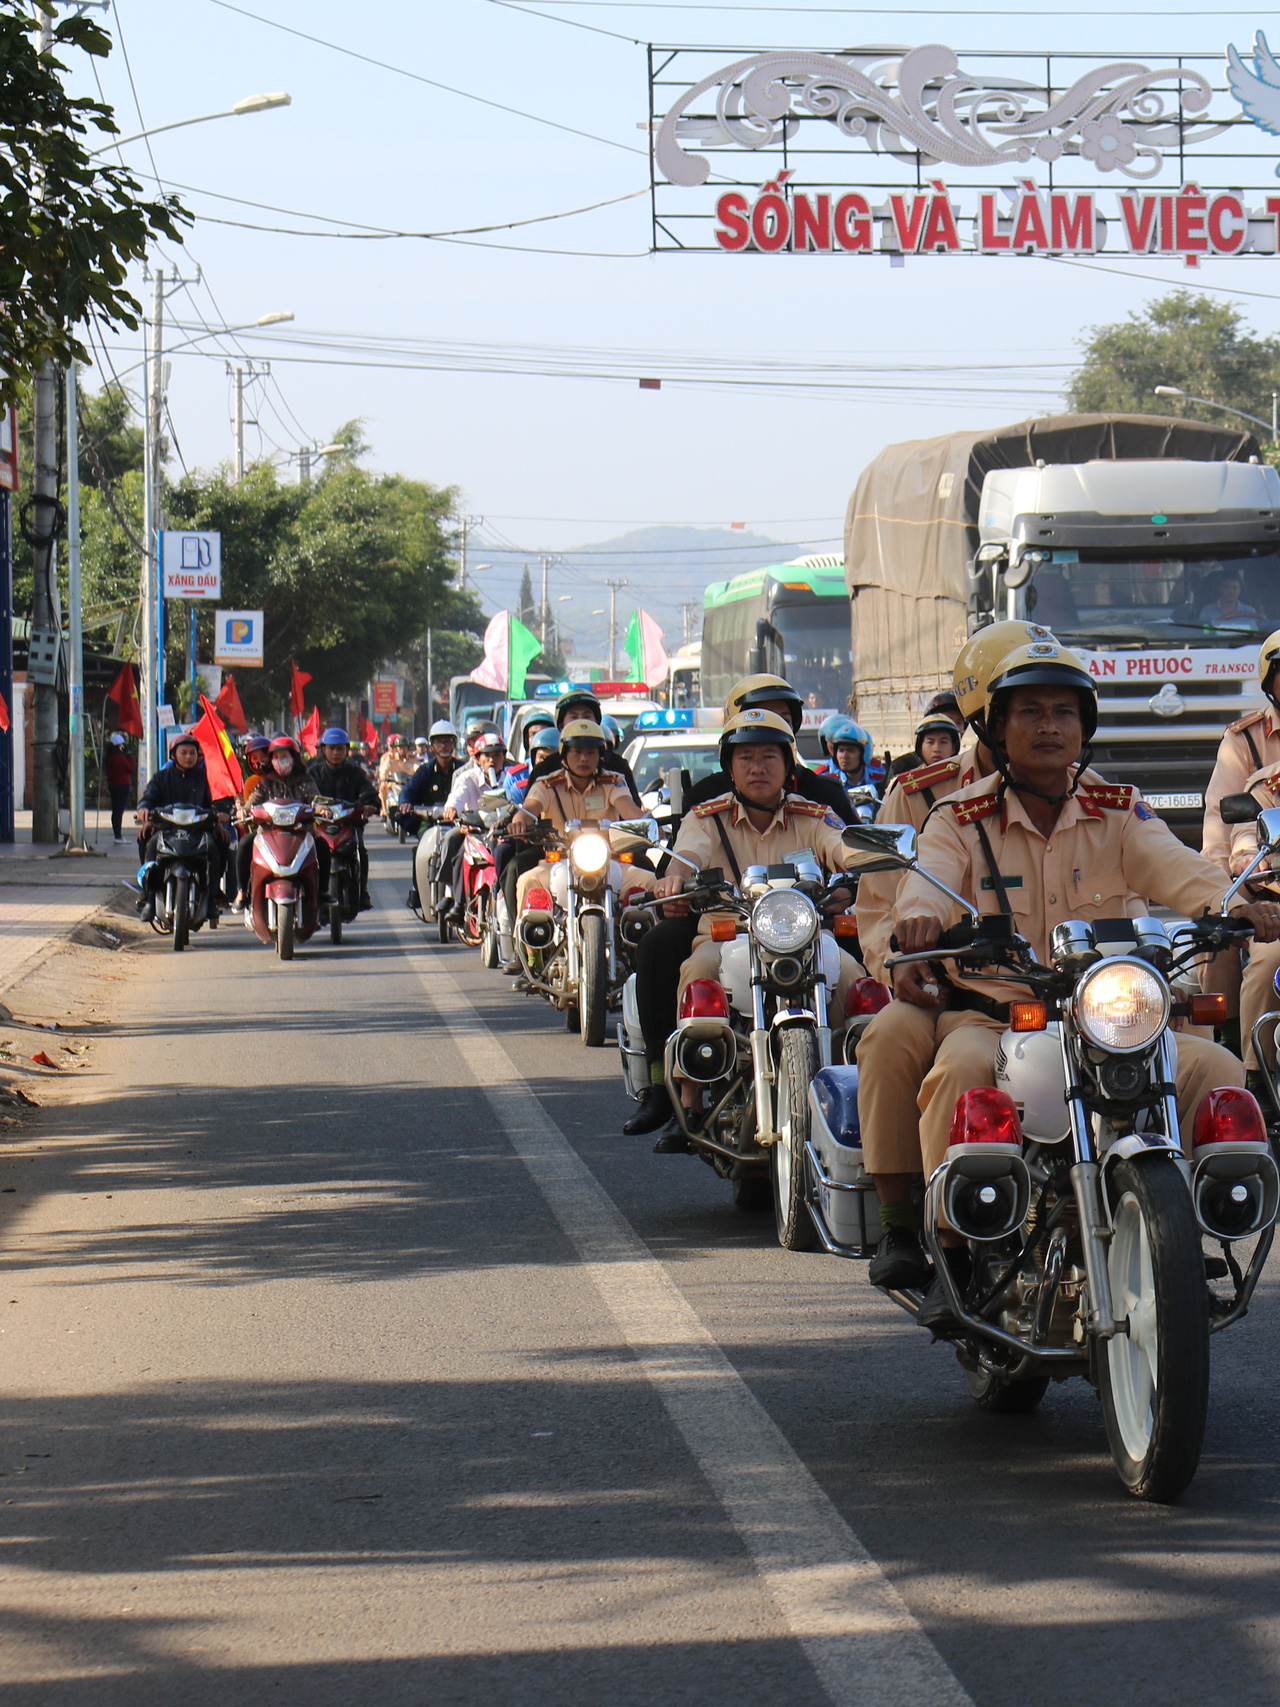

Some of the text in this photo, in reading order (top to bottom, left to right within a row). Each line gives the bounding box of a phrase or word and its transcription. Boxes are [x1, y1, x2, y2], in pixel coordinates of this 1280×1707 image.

[714, 169, 872, 252] SỐNG
[888, 178, 962, 252] VÀ
[978, 176, 1095, 254] LÀM
[1116, 180, 1248, 268] VIỆC
[168, 573, 195, 586] XĂNG
[1126, 657, 1193, 676] PHUOC
[1205, 663, 1255, 674] TRANSCO
